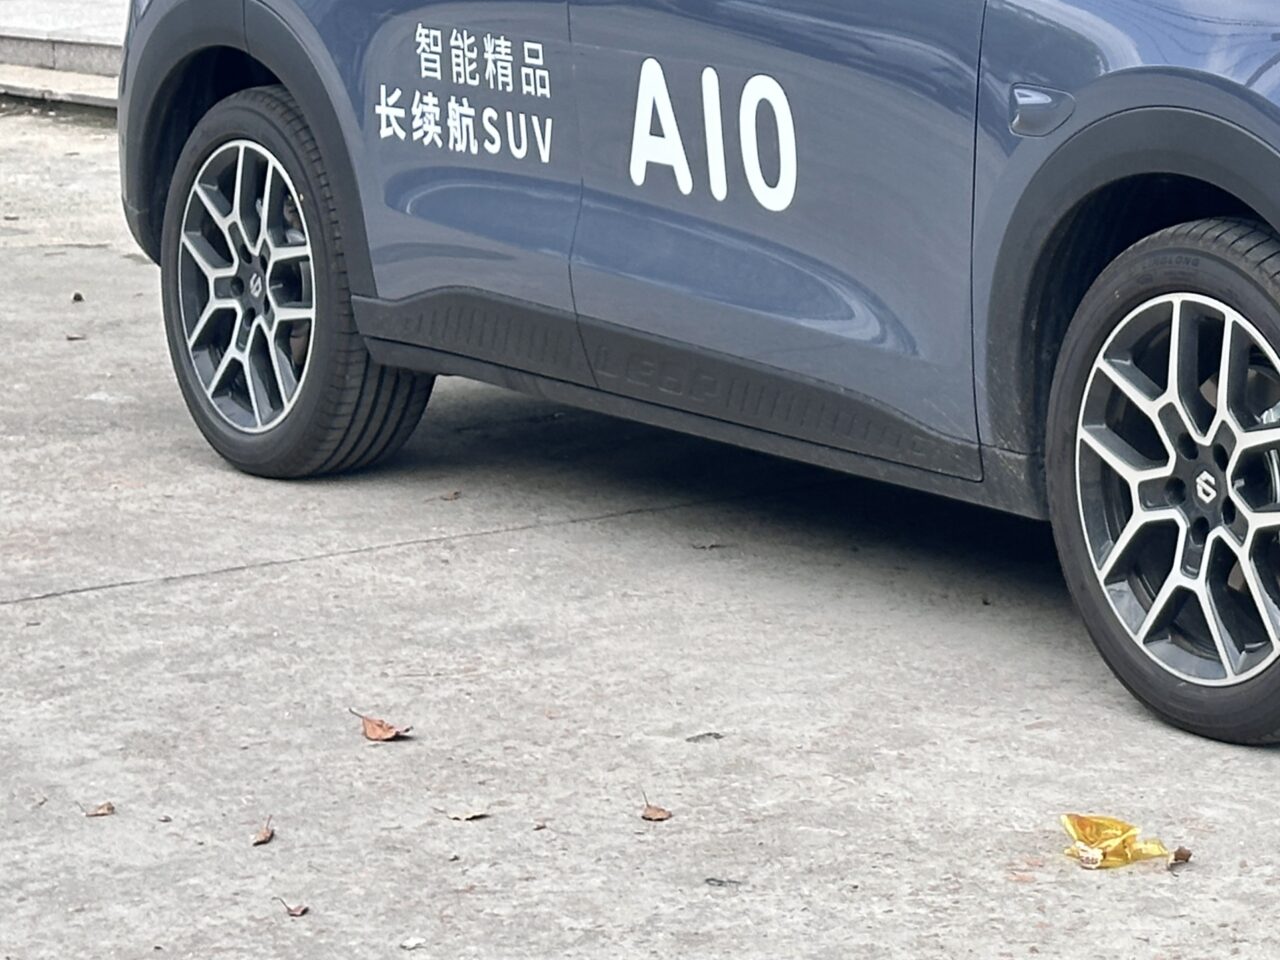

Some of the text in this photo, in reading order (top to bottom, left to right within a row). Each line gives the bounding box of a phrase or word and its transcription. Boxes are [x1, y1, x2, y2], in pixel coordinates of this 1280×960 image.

[414, 21, 552, 100] 智能精品
[374, 83, 554, 165] 长续航SUV
